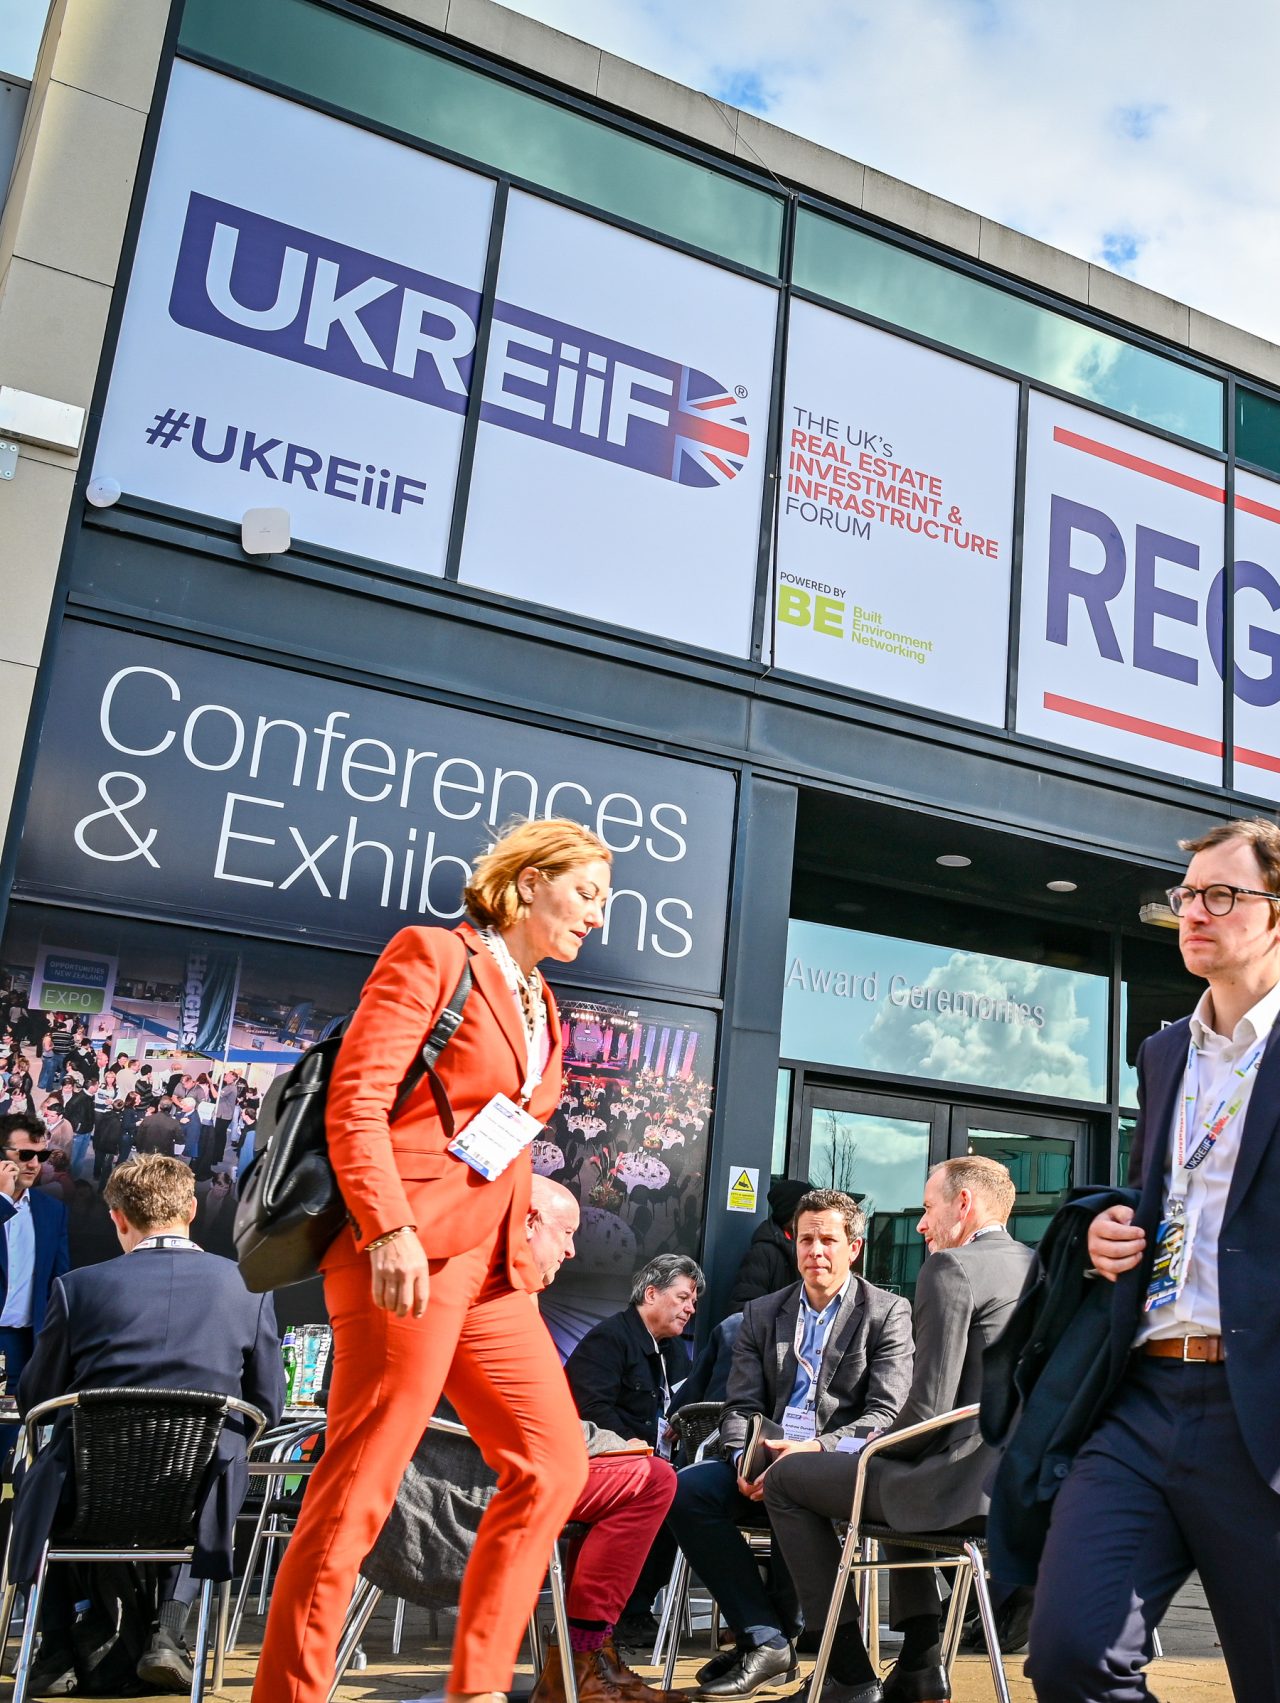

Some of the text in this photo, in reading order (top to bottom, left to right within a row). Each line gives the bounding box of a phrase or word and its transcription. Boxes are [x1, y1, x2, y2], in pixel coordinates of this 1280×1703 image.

[205, 221, 674, 448] UKREiiF
[145, 408, 428, 516] #UKREiiF
[791, 428, 942, 497] REAL ESTATE
[793, 406, 893, 458] THE UK's
[785, 496, 871, 541] FORUM
[787, 473, 998, 560] INFRASTRUCTURE
[789, 451, 963, 526] INVESTMENT &
[777, 584, 845, 639] BE
[780, 571, 847, 598] POWERED BY
[853, 606, 882, 625] Built
[851, 631, 926, 665] Networking
[852, 618, 933, 651] Environment
[100, 666, 688, 863] Conferences
[73, 770, 694, 959] & Exhibns
[44, 989, 92, 1007] EXPO
[785, 958, 1046, 1029] Award Ceremonies
